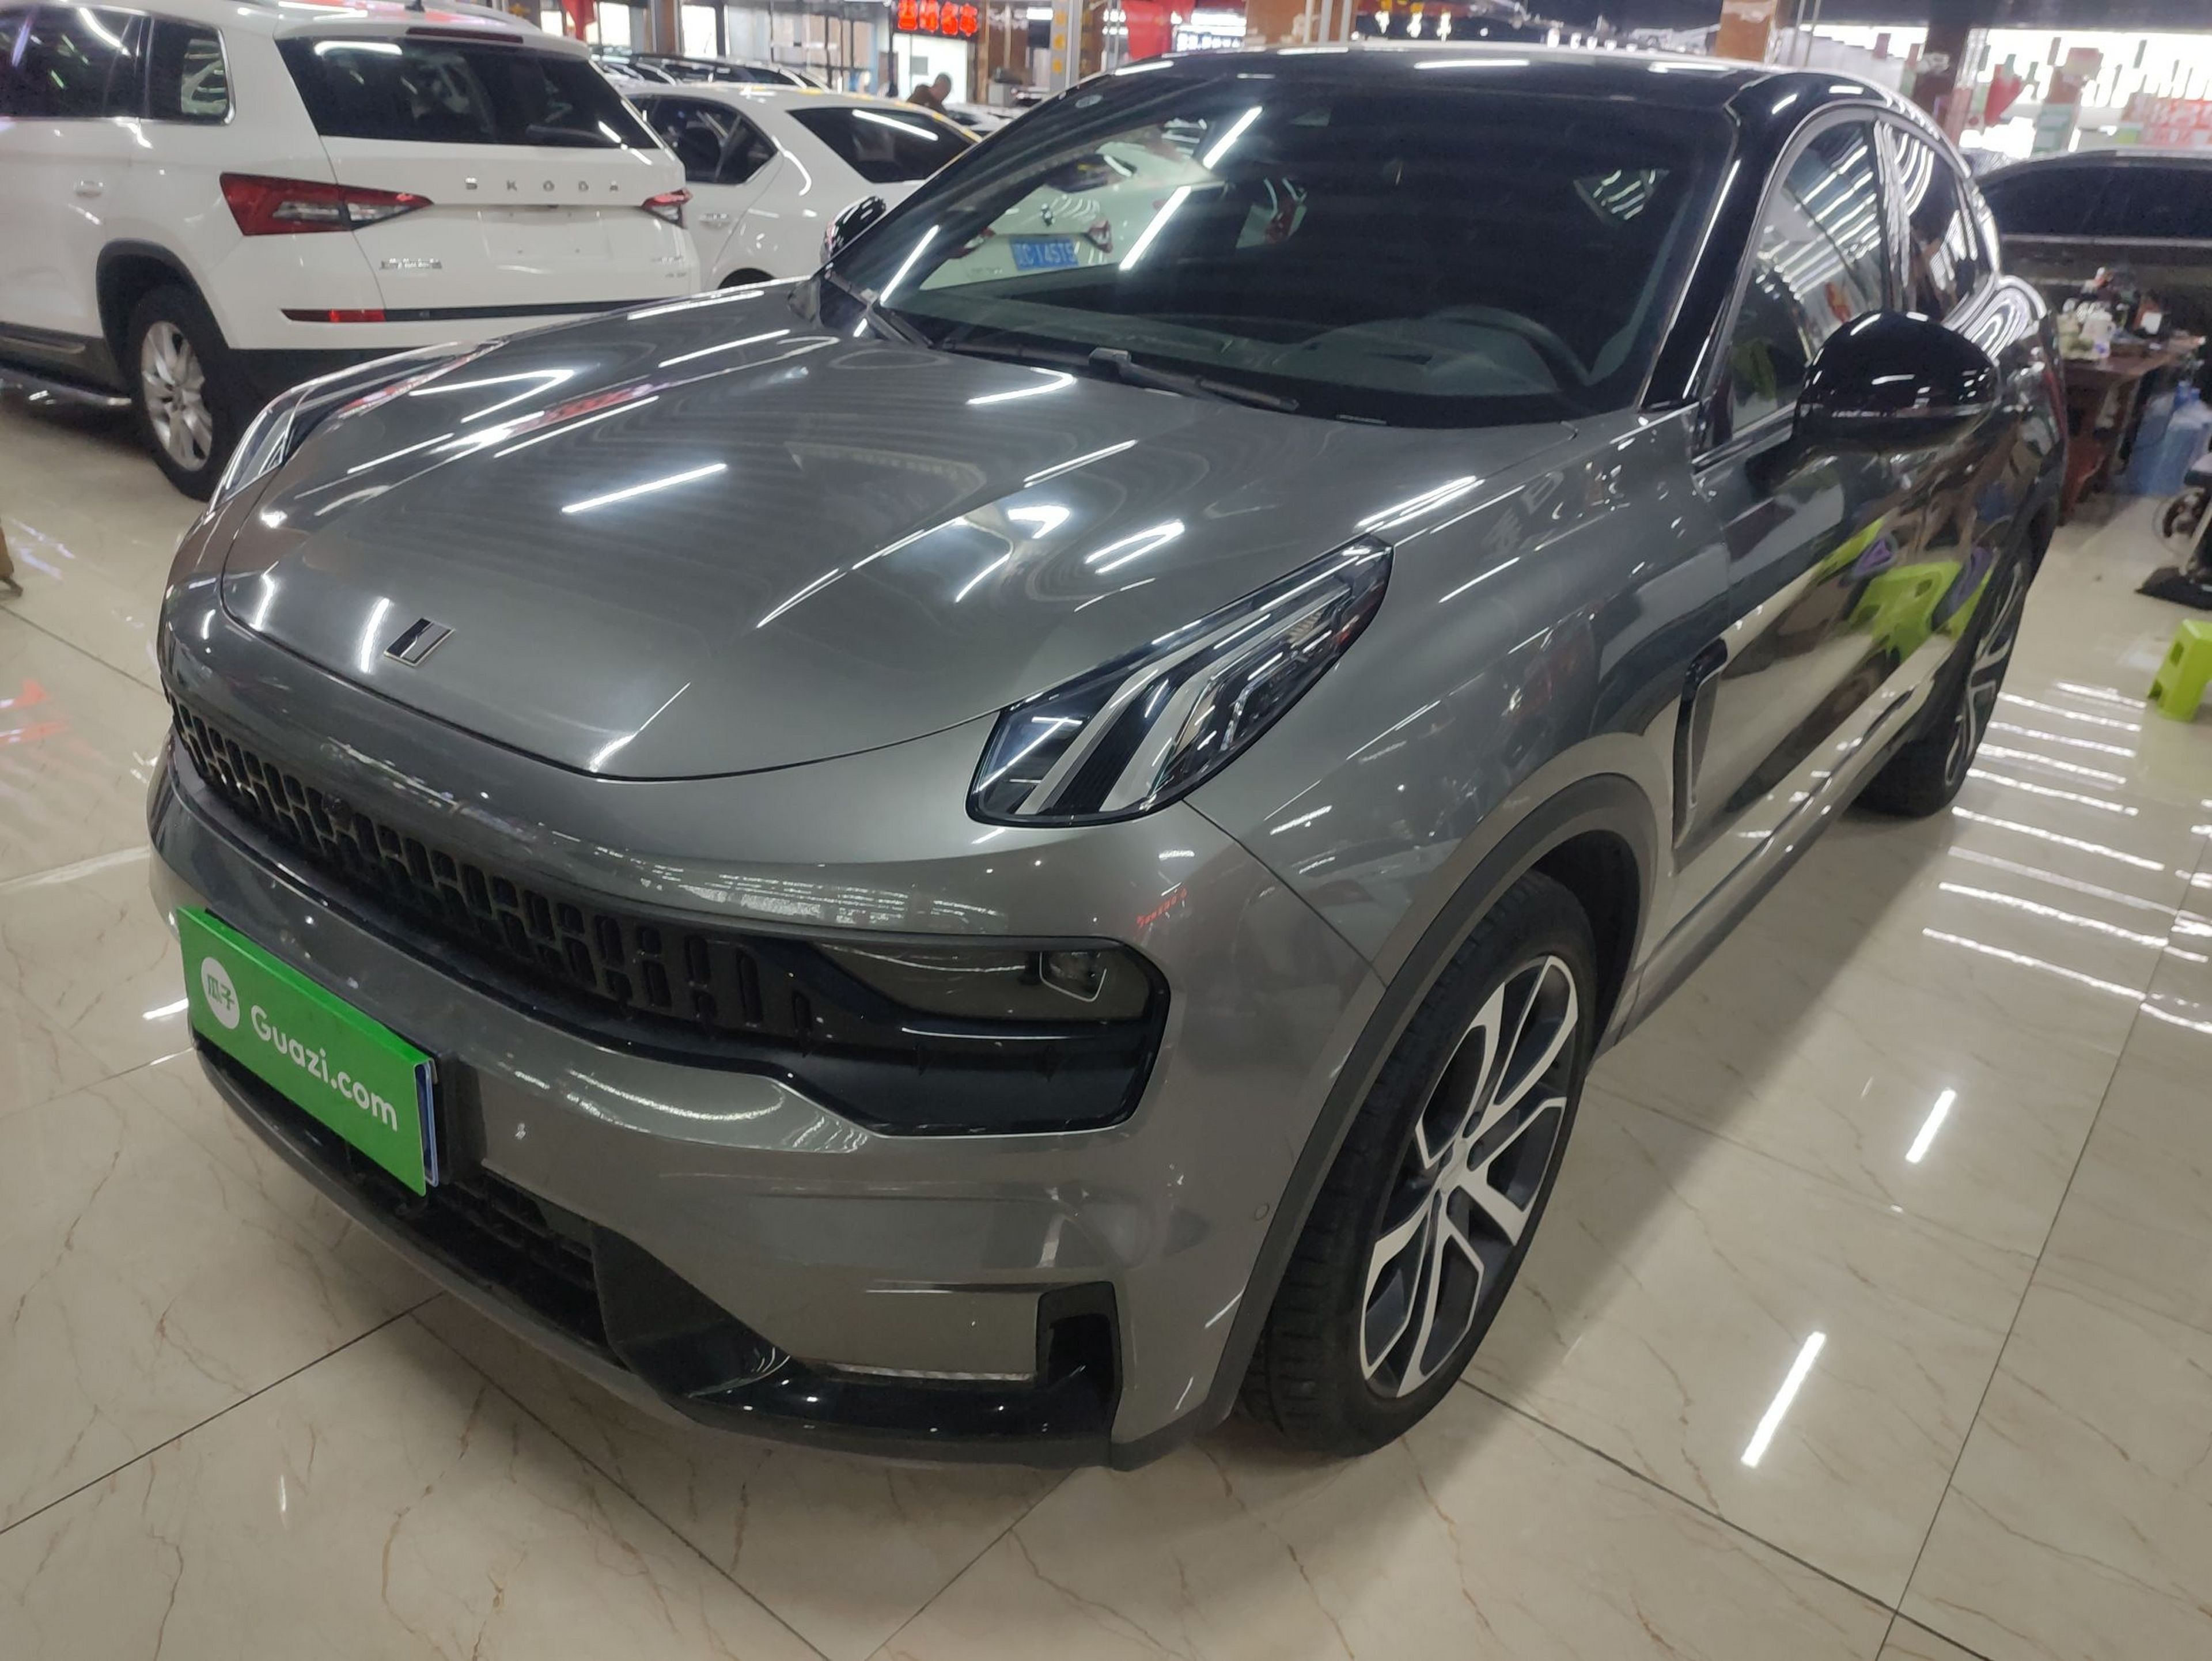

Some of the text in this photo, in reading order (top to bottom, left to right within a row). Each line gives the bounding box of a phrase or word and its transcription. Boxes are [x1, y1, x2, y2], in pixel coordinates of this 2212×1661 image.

[465, 176, 619, 192] SKODA
[207, 974, 235, 1011] 瓜子
[251, 1004, 398, 1133] Guazi.com
